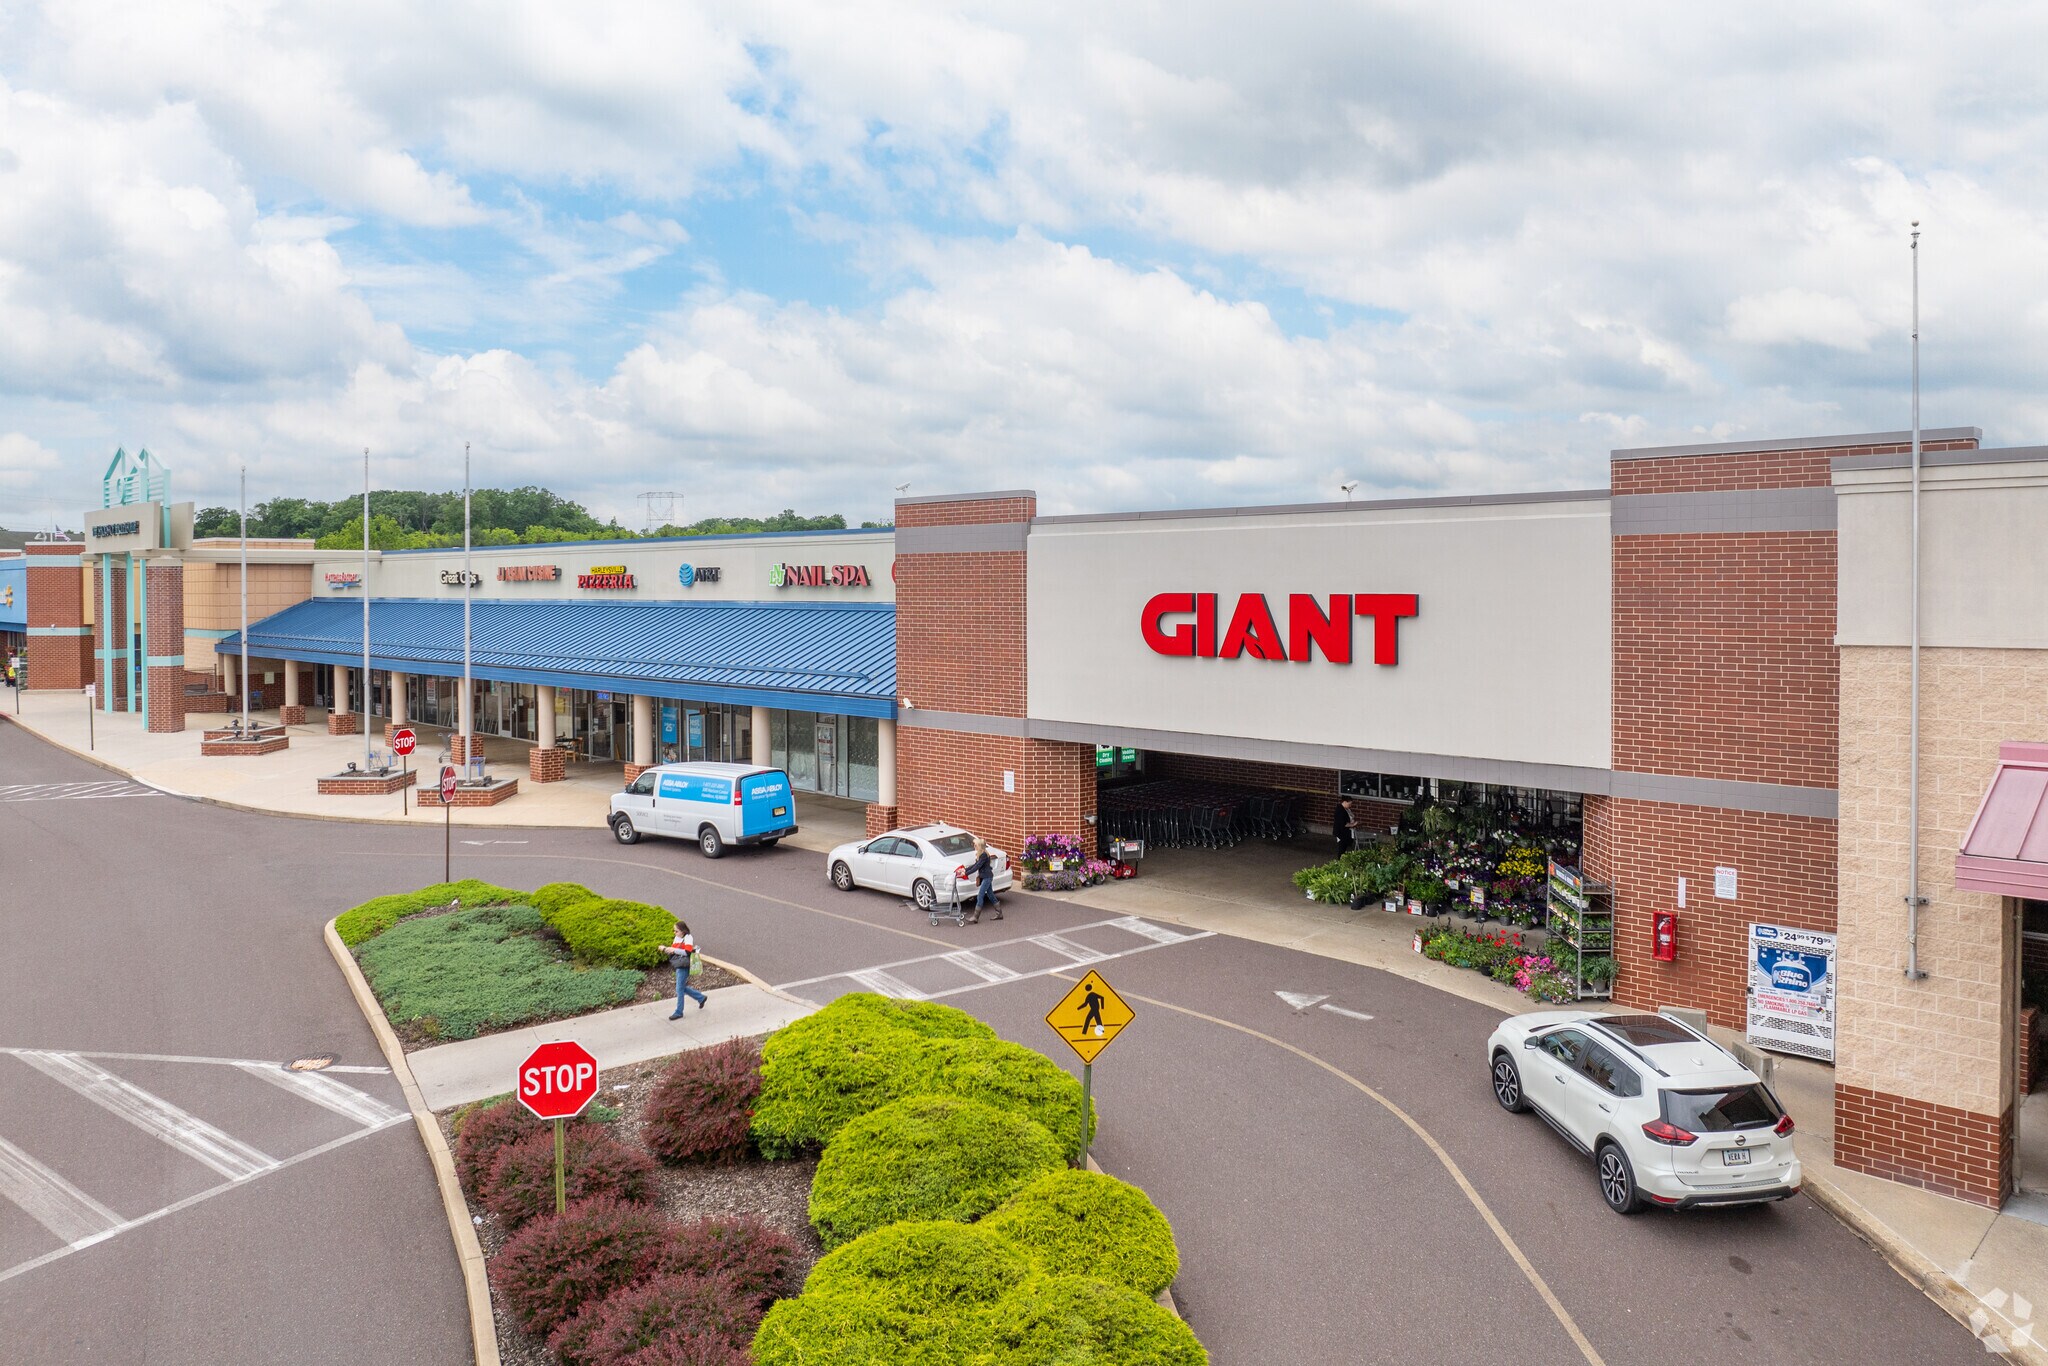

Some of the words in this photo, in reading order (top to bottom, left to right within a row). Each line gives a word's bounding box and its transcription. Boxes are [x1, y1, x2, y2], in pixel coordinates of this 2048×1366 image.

[527, 565, 556, 581] CUISINE
[590, 565, 624, 574] HARLEYSVILLE
[694, 567, 720, 583] AT&T
[786, 565, 827, 586] NAIL
[830, 564, 869, 586] SPA
[440, 570, 459, 584] Great
[577, 574, 634, 589] PIZZERIA
[1141, 593, 1419, 666] GIANT
[395, 734, 415, 748] STOP
[442, 776, 457, 793] STOP
[662, 779, 674, 787] ASSA
[674, 780, 689, 788] ABLOY
[751, 787, 766, 795] ASSA
[766, 784, 783, 793] ABLOY
[1780, 970, 1804, 979] Blue
[1757, 993, 1785, 1002] EMERGENCIES
[1763, 1004, 1791, 1014] FLAMMABLE
[523, 1062, 593, 1096] STOP
